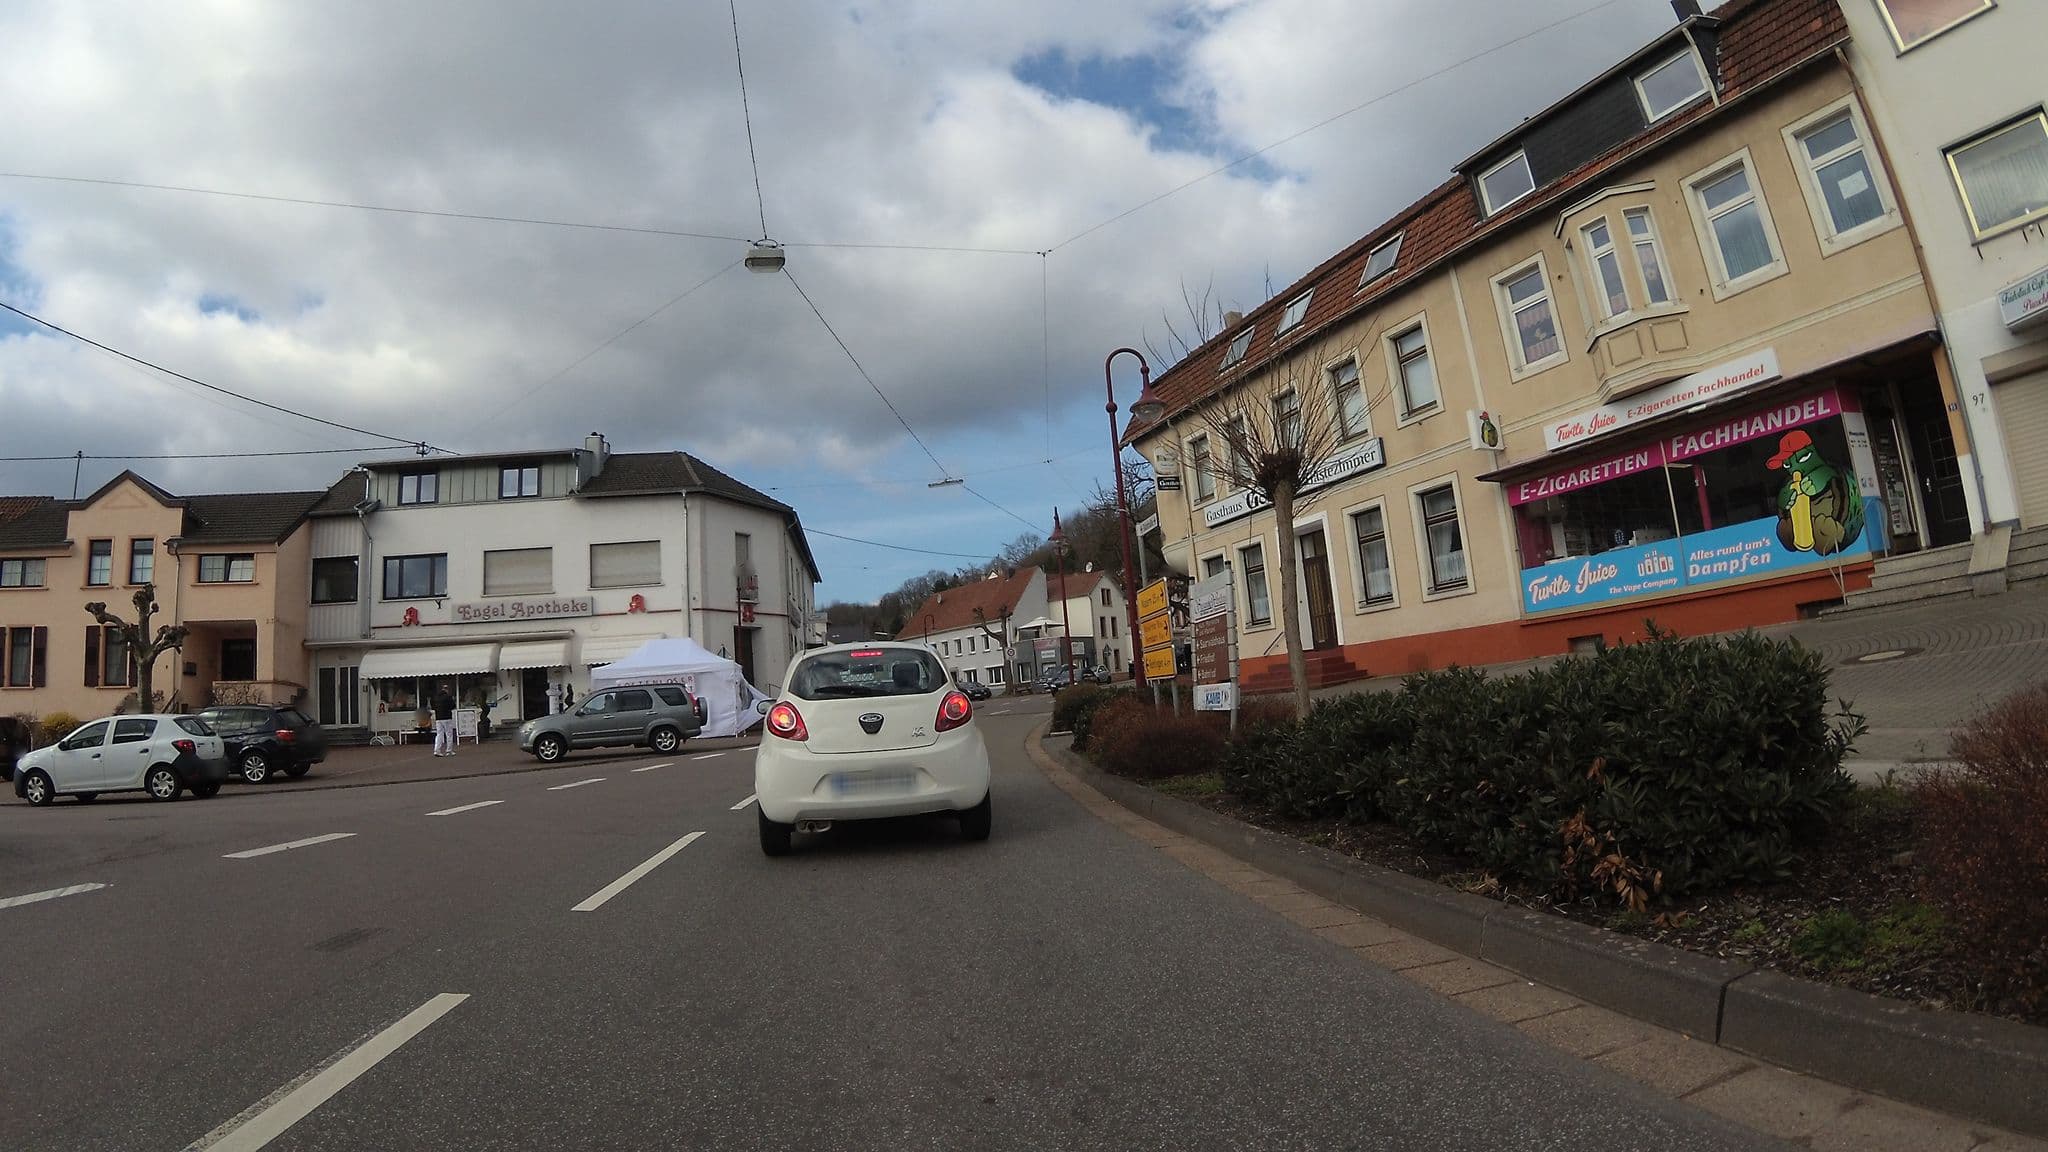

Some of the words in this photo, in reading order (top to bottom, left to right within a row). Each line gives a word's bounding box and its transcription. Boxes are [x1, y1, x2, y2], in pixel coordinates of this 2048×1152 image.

[1555, 423, 1585, 442] Turtle
[1588, 412, 1616, 435] Juice
[1627, 390, 1695, 419] E-Zigaretten
[1697, 364, 1764, 396] Fachhandel
[1972, 393, 1985, 406] 97
[1519, 451, 1650, 501] E-ZIGARETTEN
[1671, 396, 1831, 459] FACHHANDEL
[1206, 502, 1243, 523] Gasthaus
[1689, 551, 1716, 562] Alles
[1717, 543, 1743, 557] rund
[1745, 537, 1771, 550] um's
[1689, 551, 1771, 577] Dampfen
[1528, 575, 1571, 604] Turtle
[1575, 560, 1618, 594] Juice
[1609, 586, 1623, 595] The
[1624, 583, 1642, 594] Vape
[1643, 577, 1679, 591] Company
[457, 604, 505, 621] Engel
[510, 601, 588, 618] Apotheke
